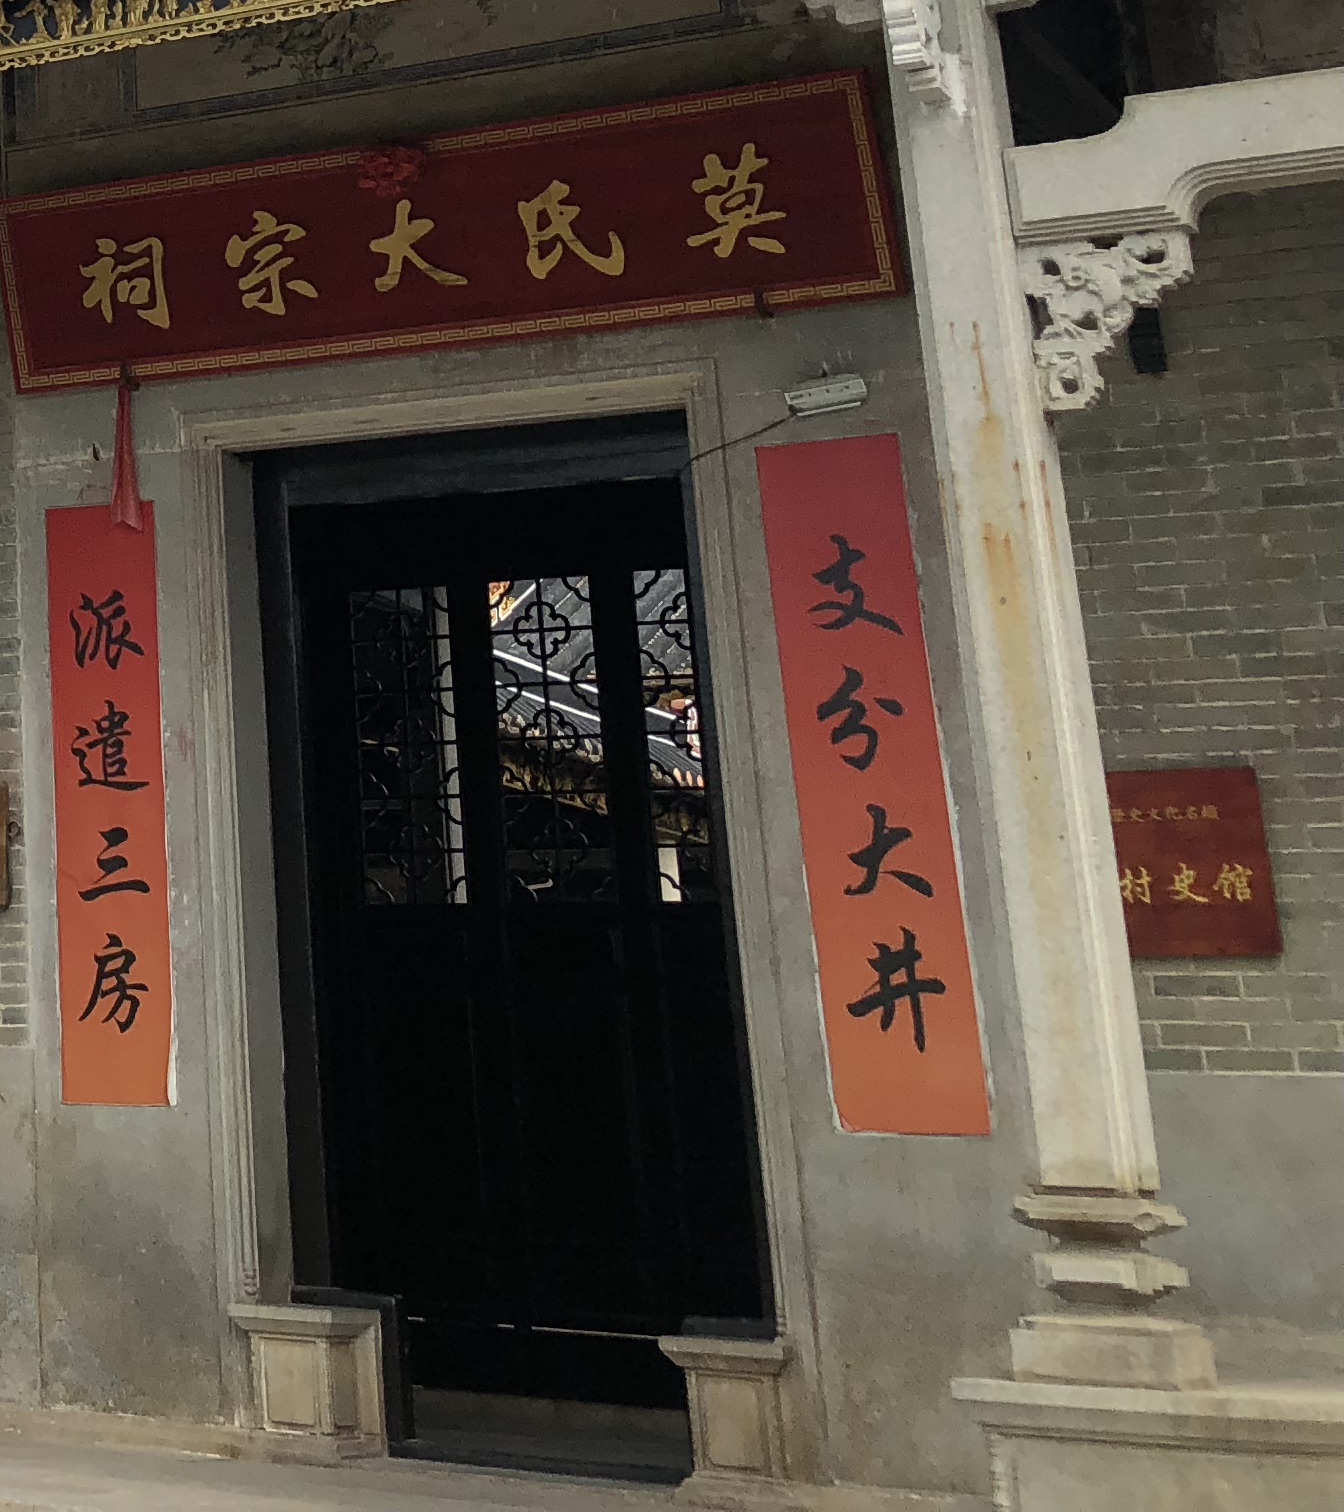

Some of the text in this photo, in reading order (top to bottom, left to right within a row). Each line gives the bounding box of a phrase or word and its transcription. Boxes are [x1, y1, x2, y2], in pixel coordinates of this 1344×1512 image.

[79, 143, 787, 330] 莫氏大宗祠
[69, 589, 151, 1034] 派遣三房
[810, 533, 947, 1053] 支分大井
